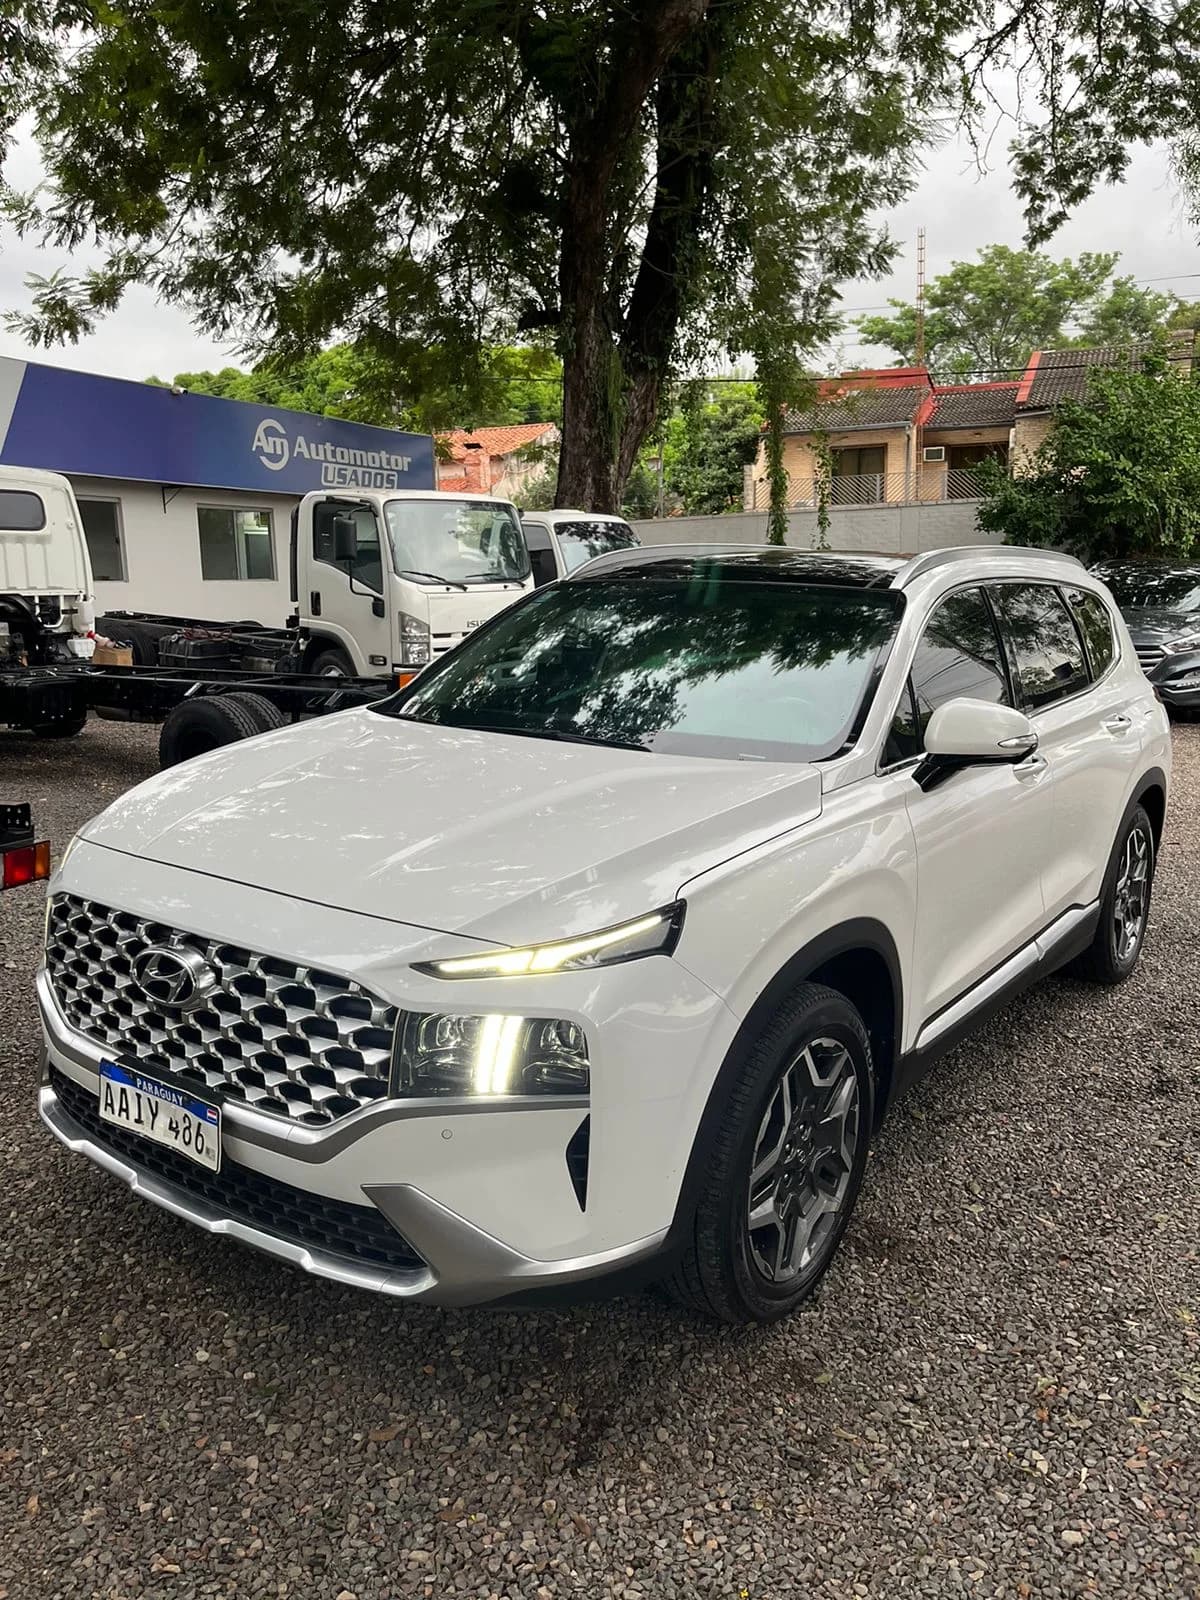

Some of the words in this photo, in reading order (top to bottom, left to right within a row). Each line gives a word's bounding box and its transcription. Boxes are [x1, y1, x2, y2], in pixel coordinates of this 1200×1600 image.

[294, 436, 412, 472] Automotor
[323, 465, 396, 489] USADOS
[466, 619, 486, 628] ISU
[136, 1078, 183, 1106] PARAGUAY
[104, 1082, 159, 1131] AAIY
[168, 1113, 205, 1155] 486
